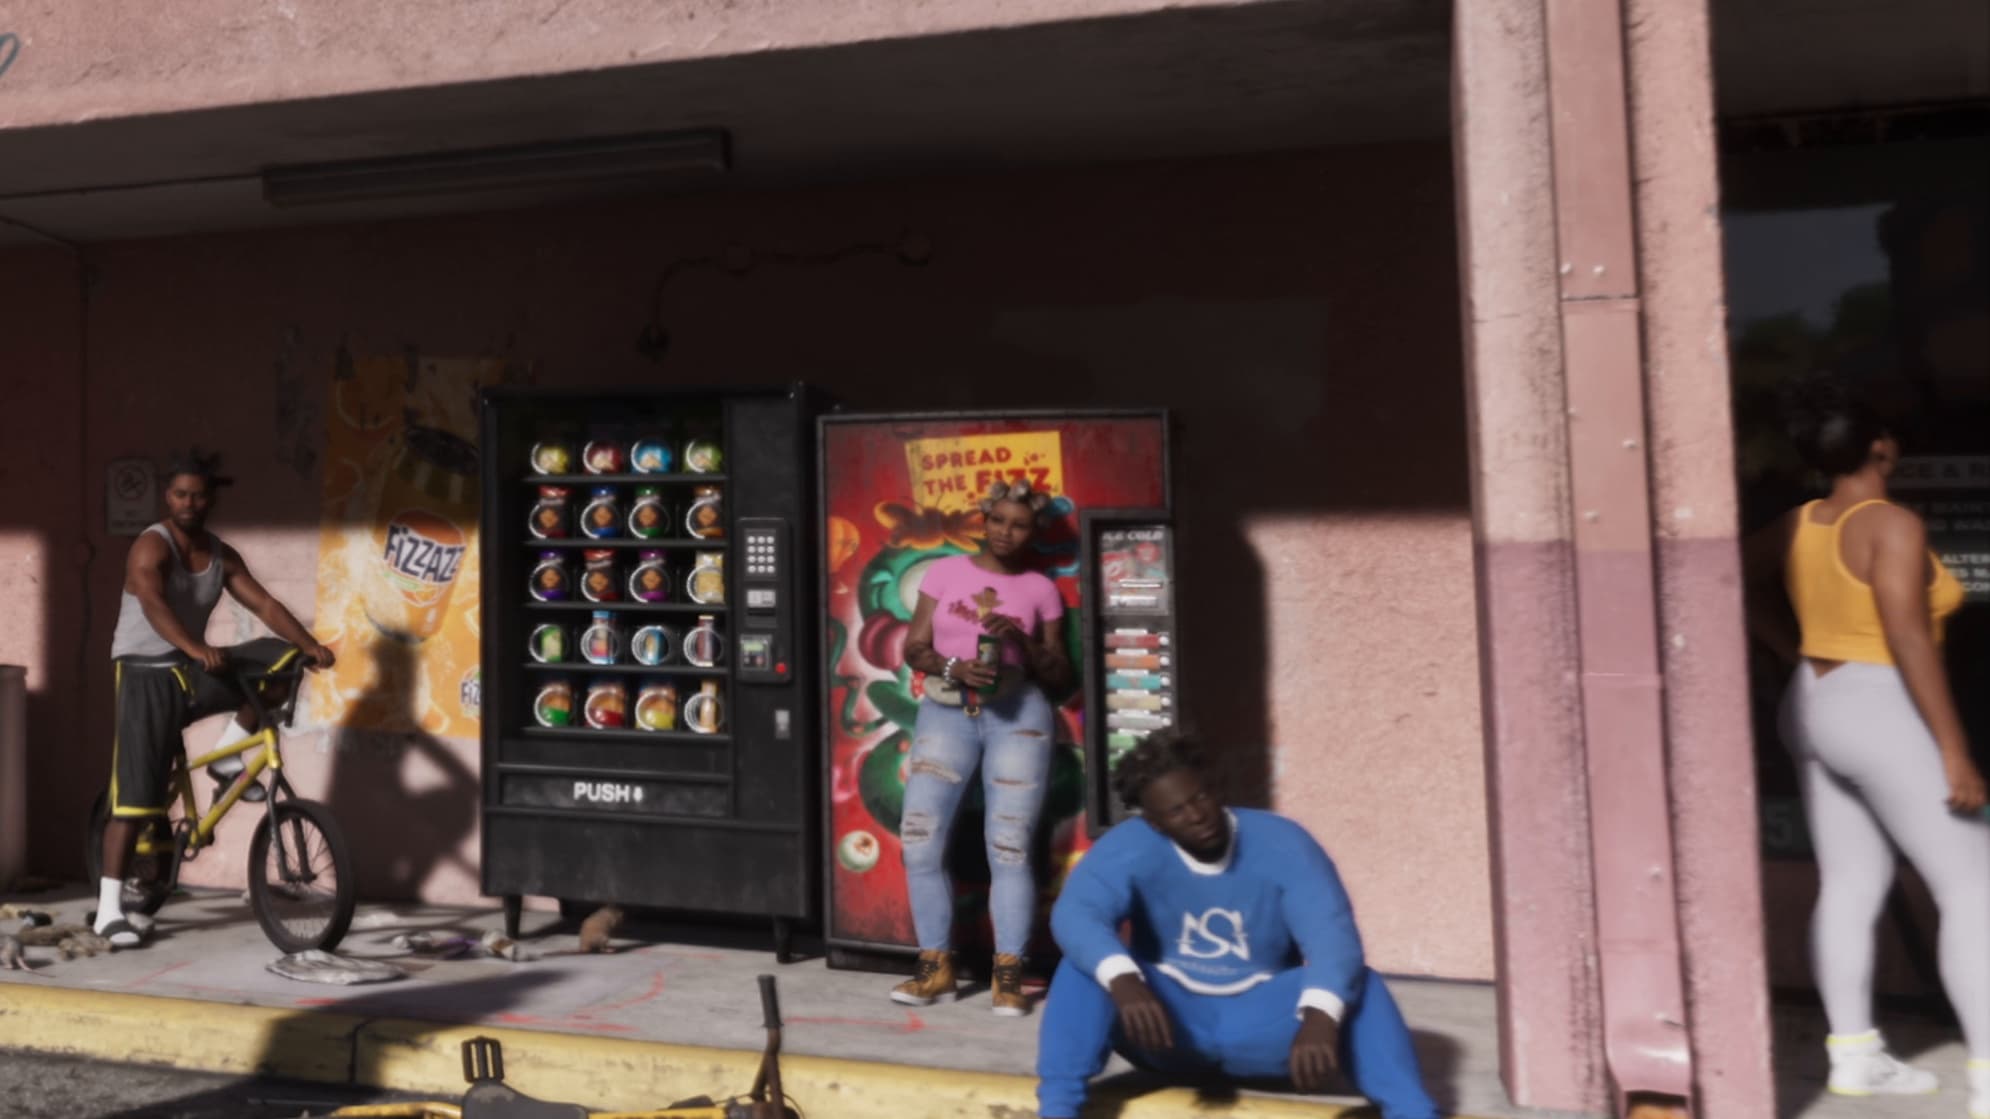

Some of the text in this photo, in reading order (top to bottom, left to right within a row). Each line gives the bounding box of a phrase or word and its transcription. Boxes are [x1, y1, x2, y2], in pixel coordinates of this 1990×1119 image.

[921, 446, 1012, 471] SPREAD
[923, 474, 967, 496] THE
[1127, 530, 1164, 541] COLD
[573, 781, 630, 802] PUSH
